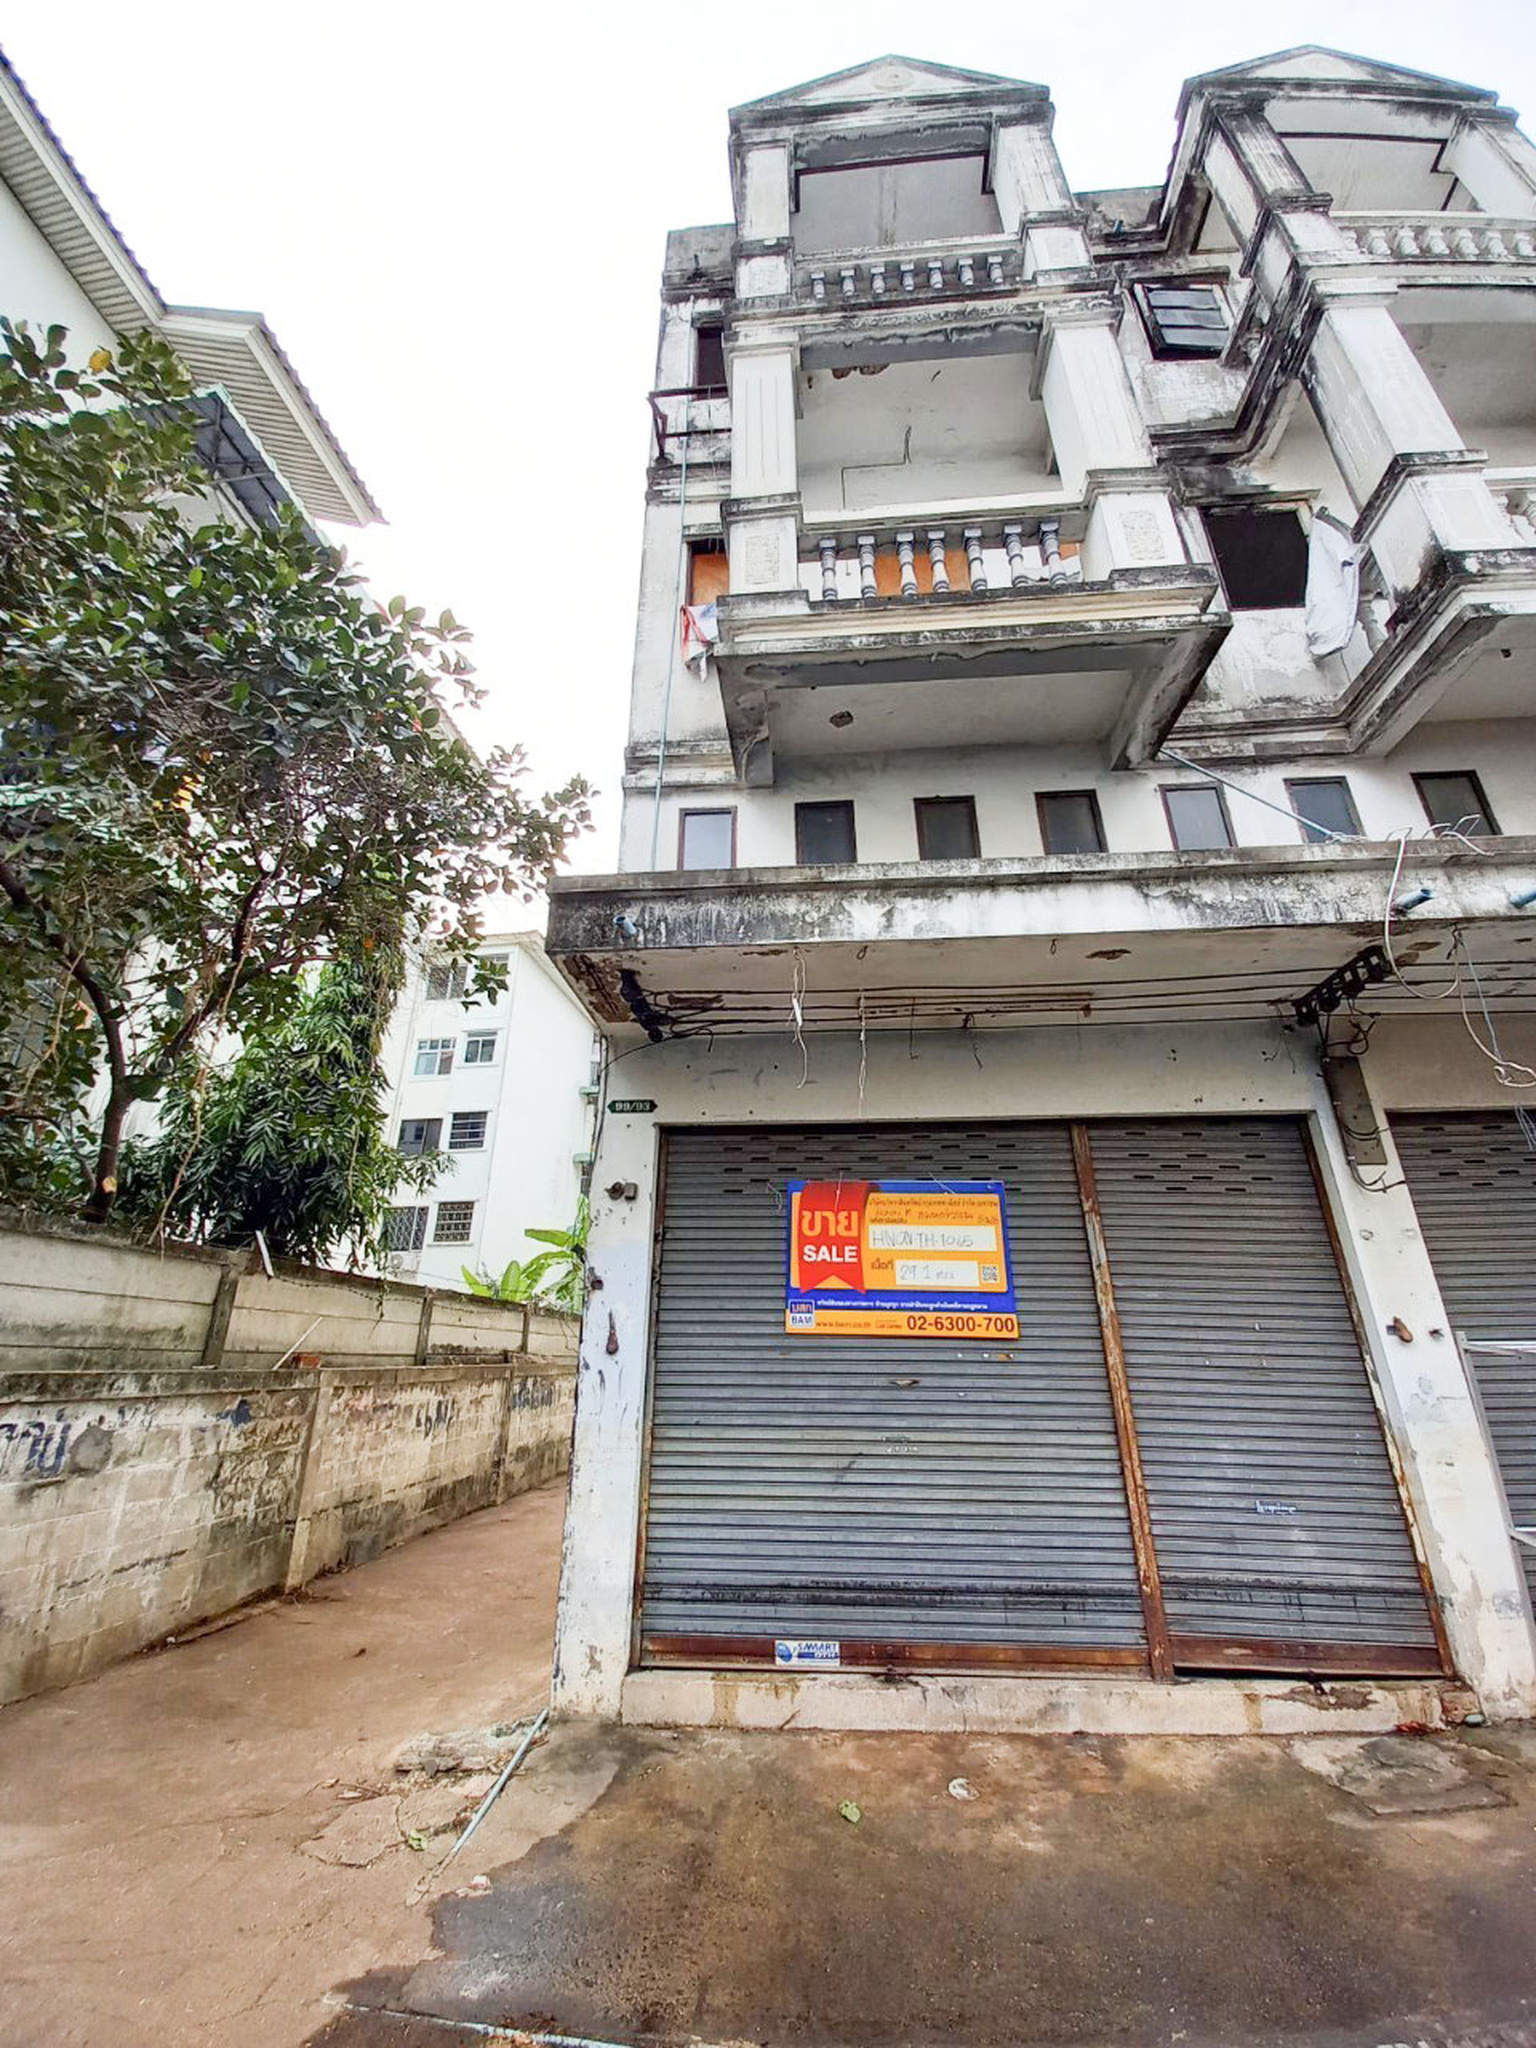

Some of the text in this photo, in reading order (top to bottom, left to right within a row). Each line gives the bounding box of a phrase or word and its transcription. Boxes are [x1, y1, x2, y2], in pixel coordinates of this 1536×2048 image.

[801, 1210, 859, 1238] ขาย
[803, 1245, 858, 1263] SALE
[791, 1316, 812, 1325] BAM
[907, 1315, 1015, 1332] 02-6300-700
